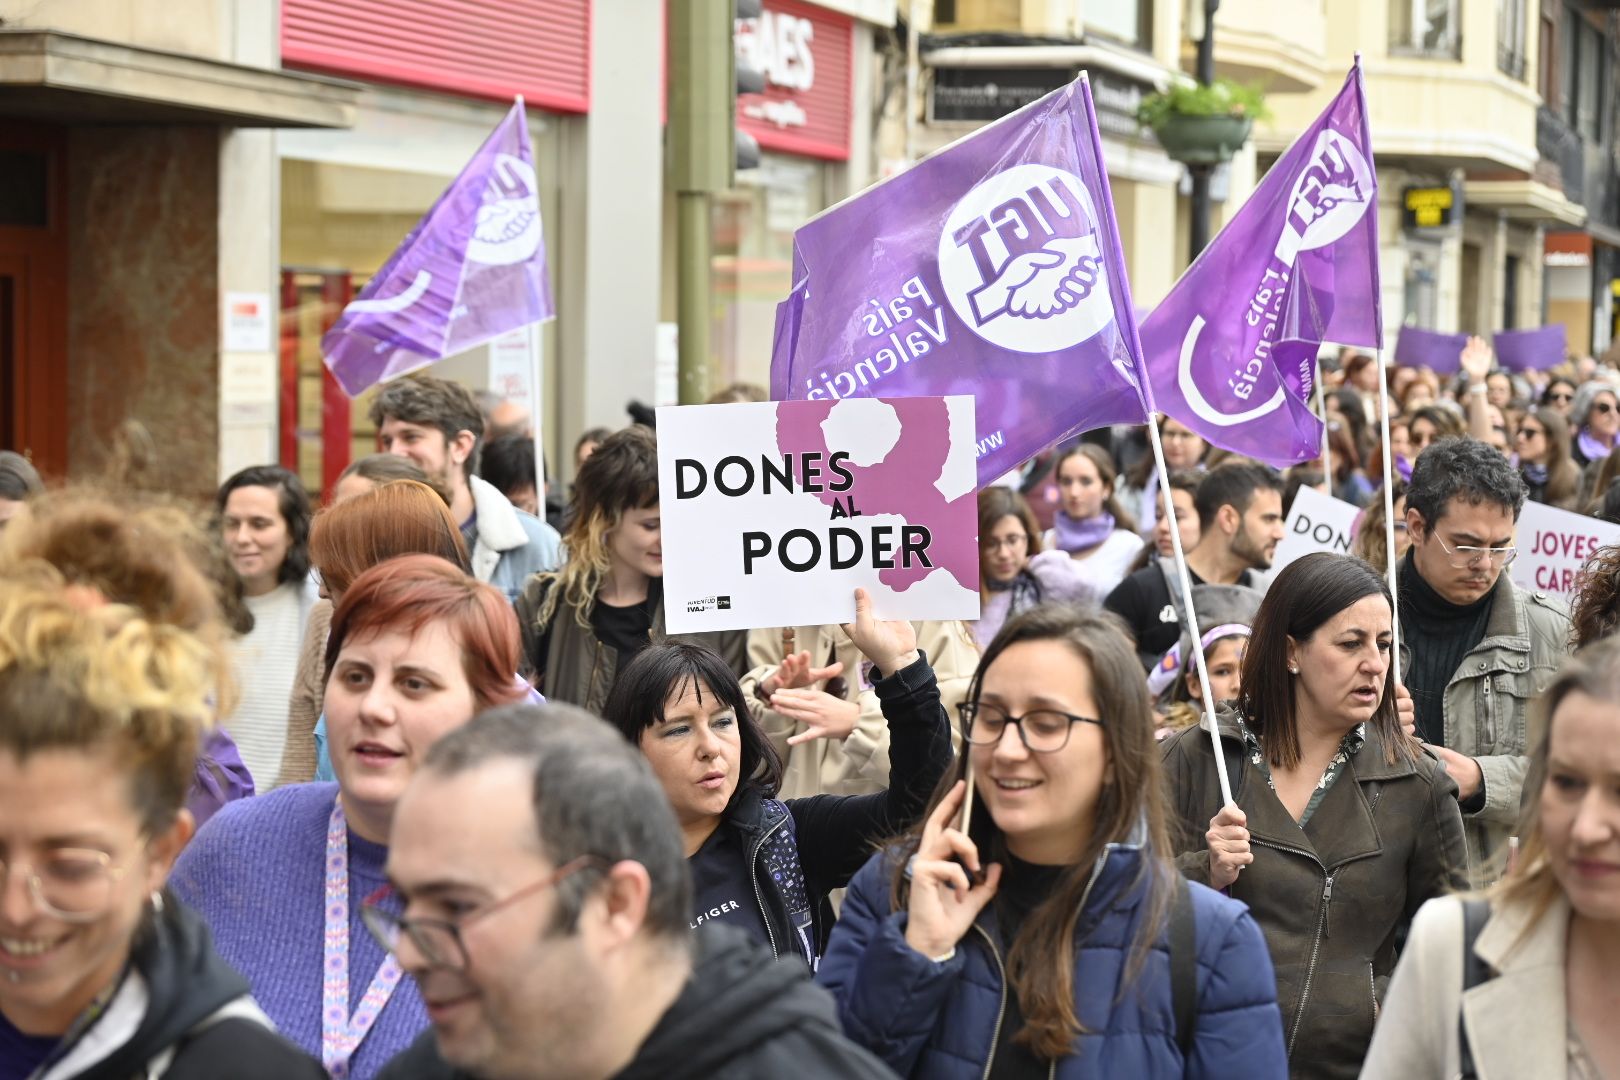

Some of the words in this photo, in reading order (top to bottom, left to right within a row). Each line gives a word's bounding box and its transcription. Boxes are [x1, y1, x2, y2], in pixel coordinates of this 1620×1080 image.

[675, 451, 854, 500] DONES
[830, 495, 862, 520] AL
[1293, 514, 1353, 552] DON
[1531, 531, 1598, 560] JOVES
[742, 525, 933, 575] PODER
[1536, 565, 1579, 592] CAR
[689, 900, 740, 930] LFIGER
